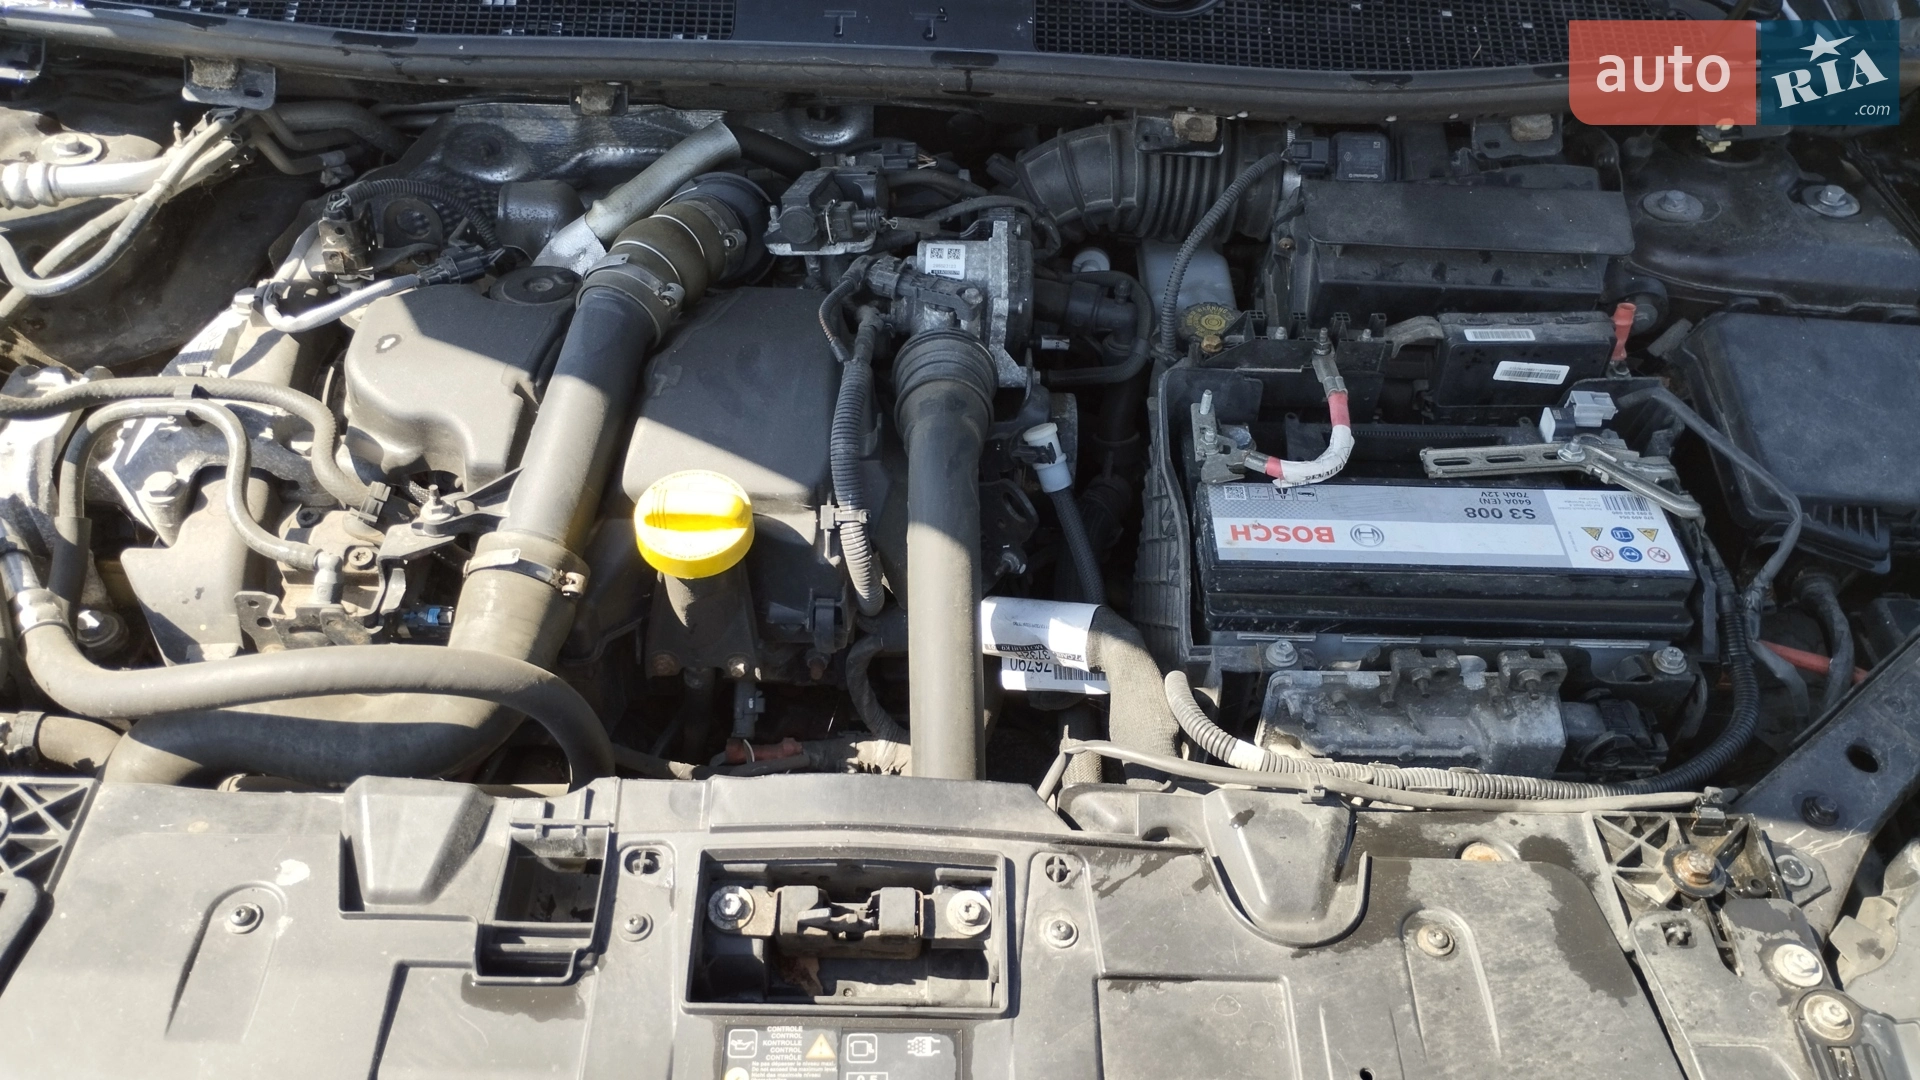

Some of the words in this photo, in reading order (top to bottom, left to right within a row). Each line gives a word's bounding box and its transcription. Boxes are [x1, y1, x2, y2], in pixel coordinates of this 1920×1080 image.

[1463, 507, 1504, 520] 008
[1508, 508, 1536, 520] S3
[1228, 524, 1336, 545] BOSCH
